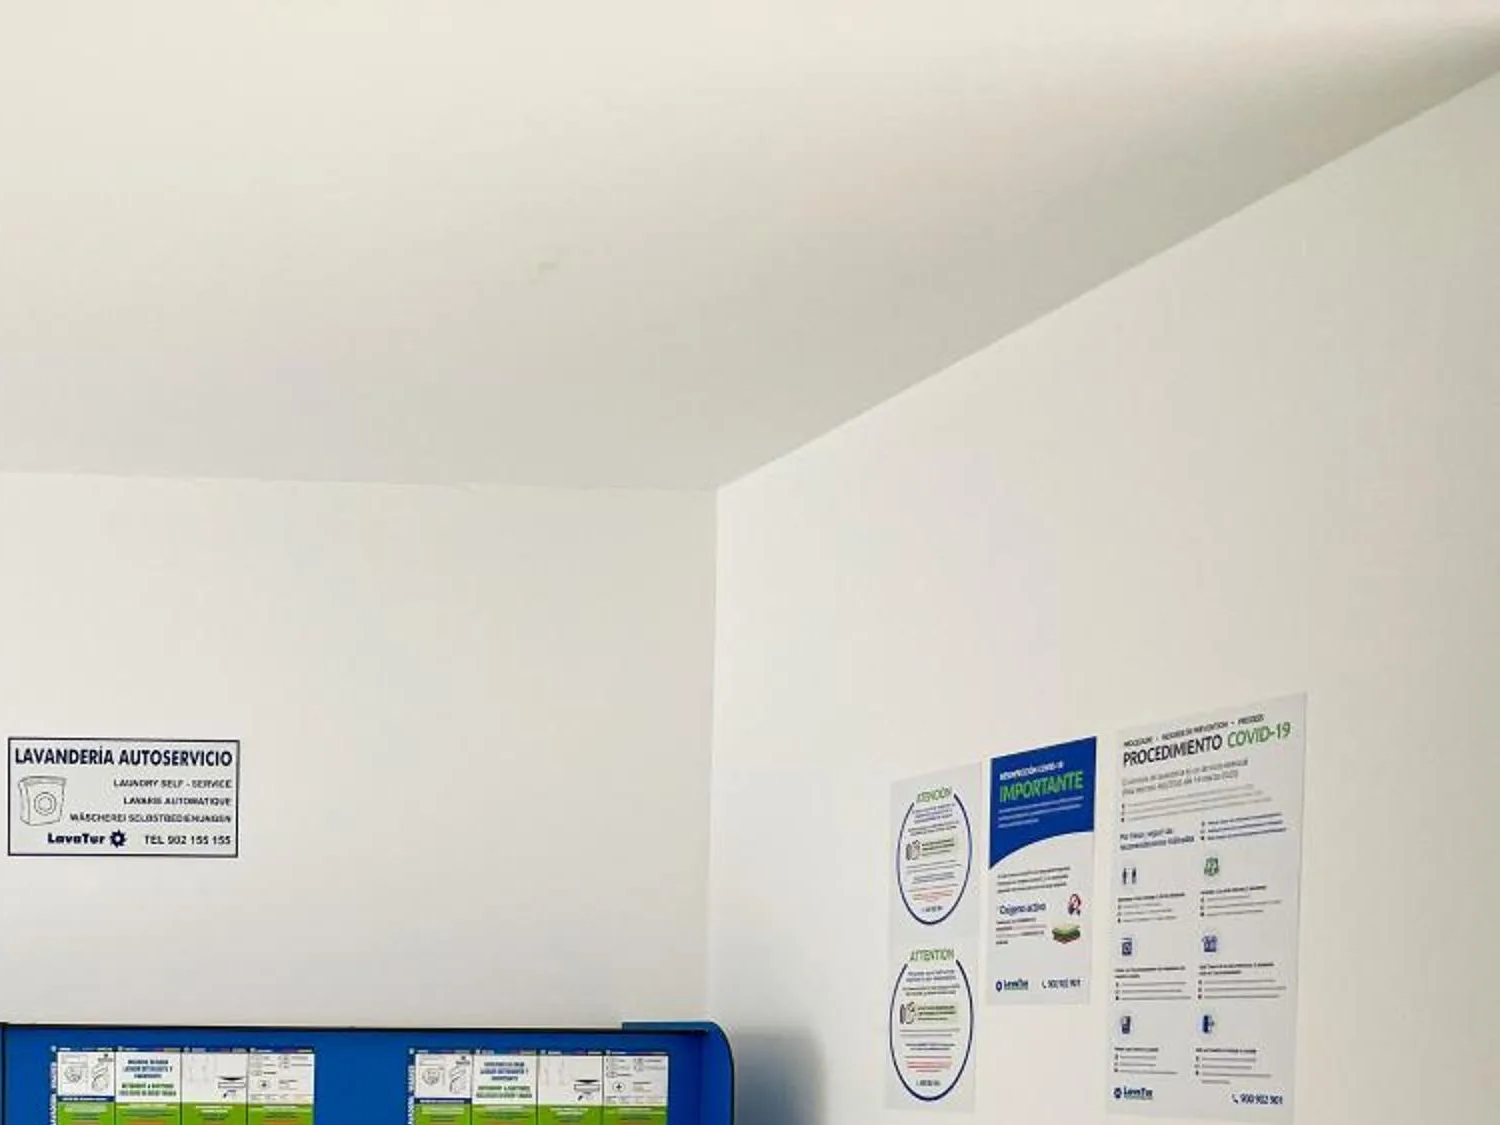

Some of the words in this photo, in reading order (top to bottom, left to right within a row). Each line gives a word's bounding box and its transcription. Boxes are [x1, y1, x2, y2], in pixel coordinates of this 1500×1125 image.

[1123, 734, 1223, 768] PROCEDIMIENTO
[1227, 721, 1291, 749] COVID-19
[15, 745, 115, 765] LAVANDERÍA
[118, 750, 233, 767] AUTOSERVICIO
[1000, 769, 1084, 803] IMPORTANTE
[47, 832, 106, 845] LavaTur
[145, 835, 165, 846] TEL
[167, 835, 187, 846] 902
[191, 835, 209, 846] 155
[213, 835, 232, 846] 155
